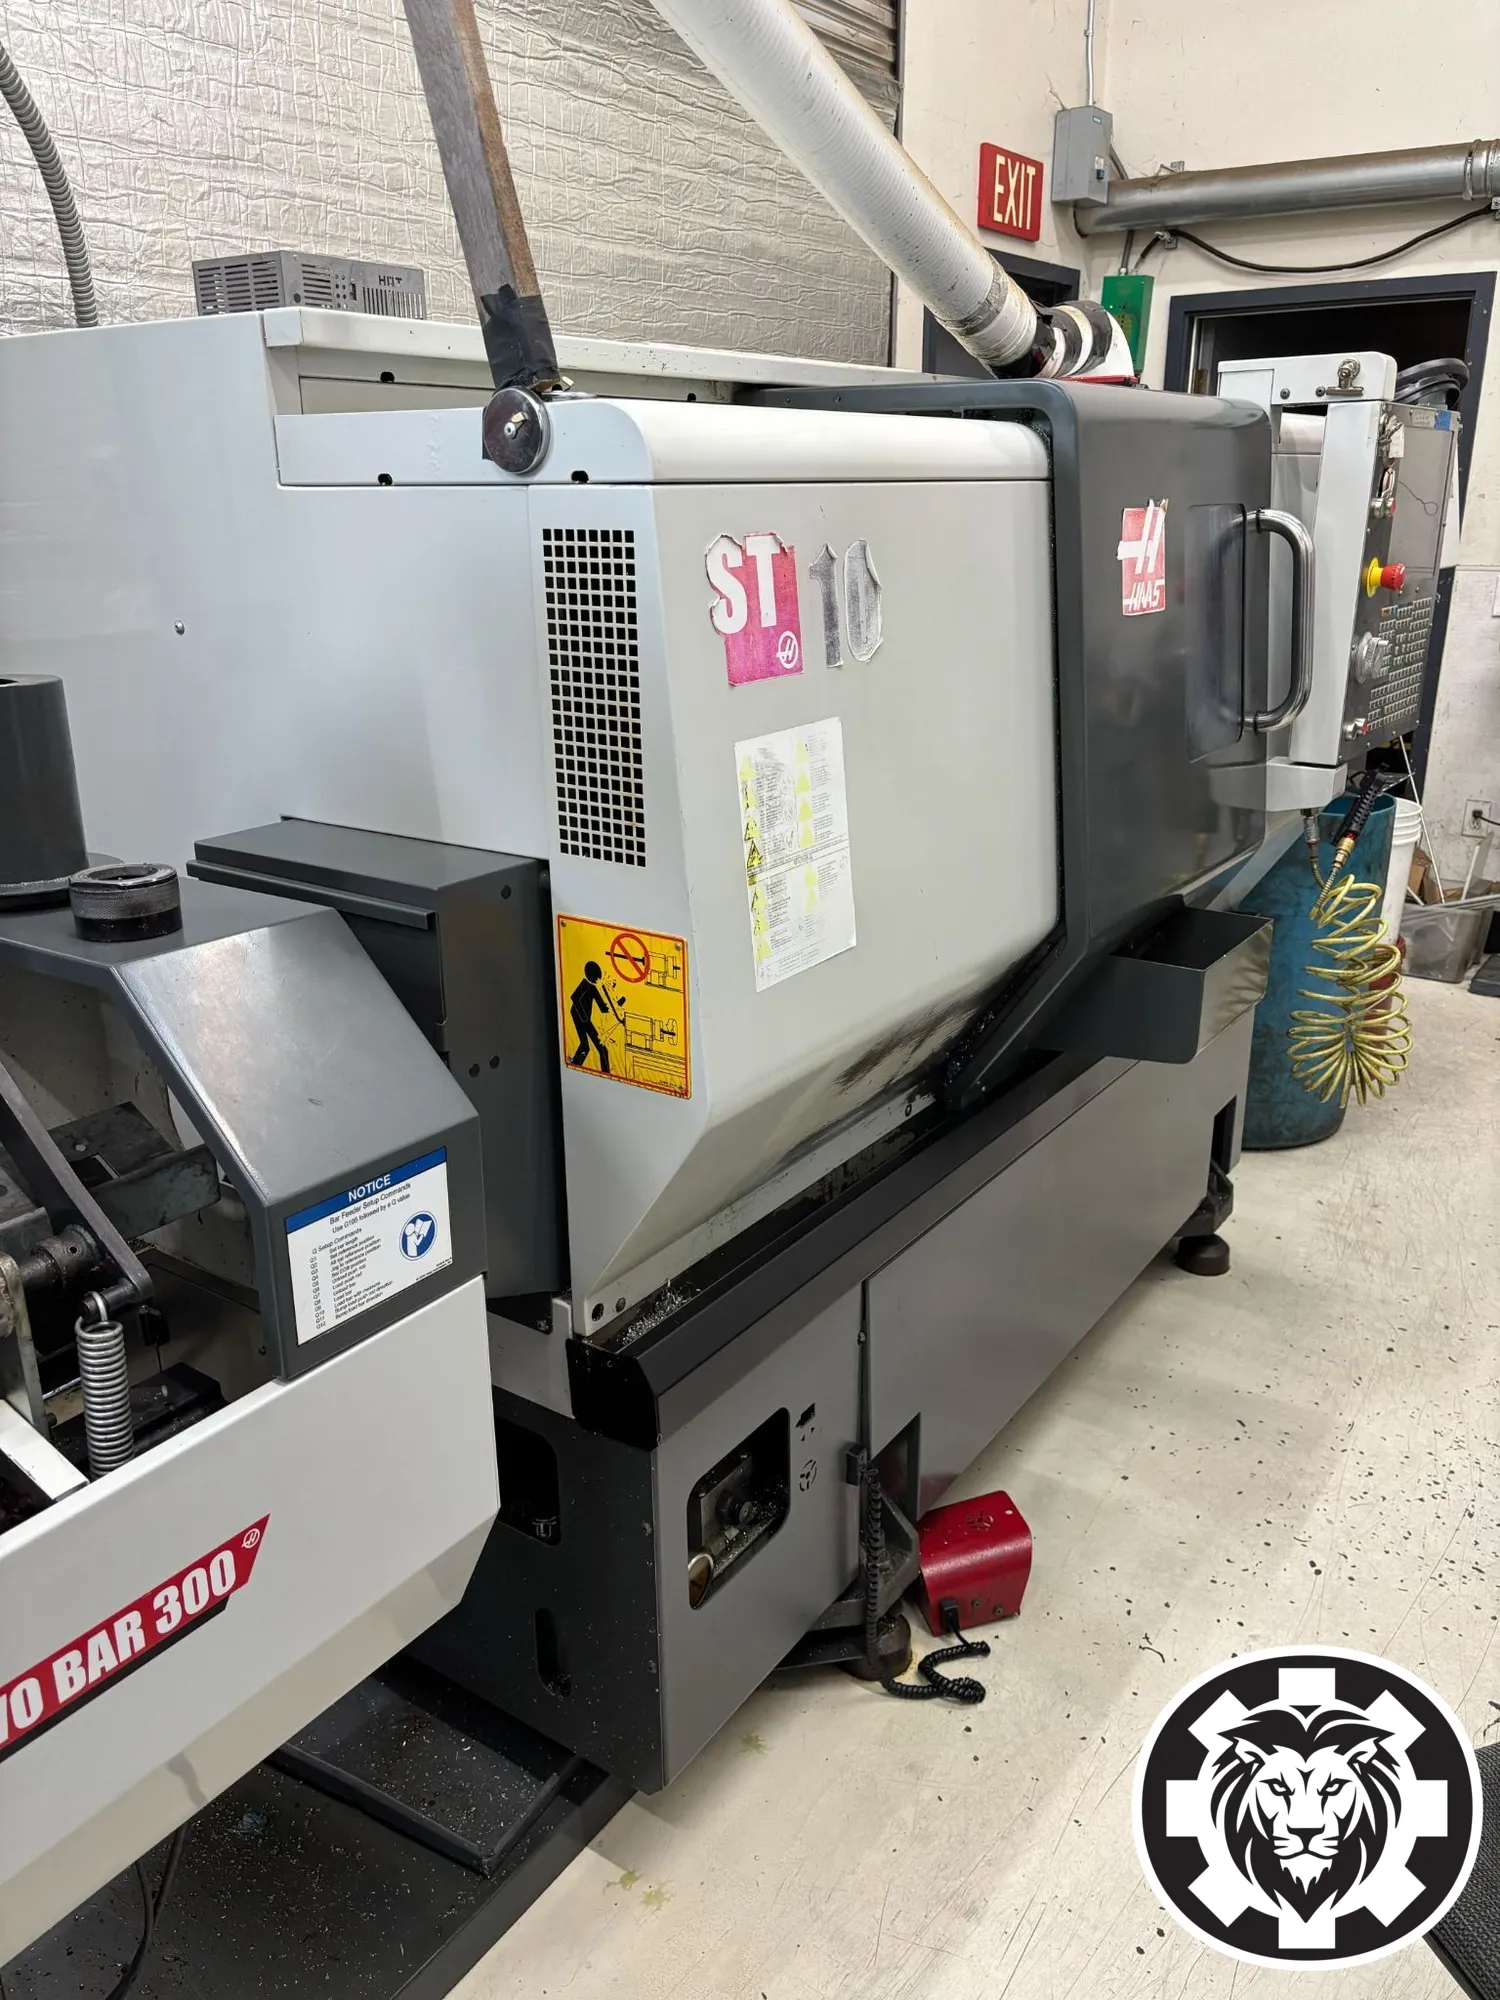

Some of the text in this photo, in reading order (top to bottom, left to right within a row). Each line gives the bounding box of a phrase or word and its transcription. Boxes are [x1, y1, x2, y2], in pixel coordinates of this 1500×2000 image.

[993, 153, 1036, 231] EXIT
[705, 533, 884, 668] ST 10
[330, 1183, 410, 1224] Bar Feeder Setup Commands
[348, 1174, 391, 1202] NOTICE
[332, 1225, 343, 1233] Use
[359, 1207, 379, 1220] followed
[397, 1194, 410, 1202] value
[318, 1242, 333, 1252] Setup
[334, 1228, 361, 1244] Commands
[52, 1610, 145, 1703] BAR
[153, 1550, 236, 1634] 300
